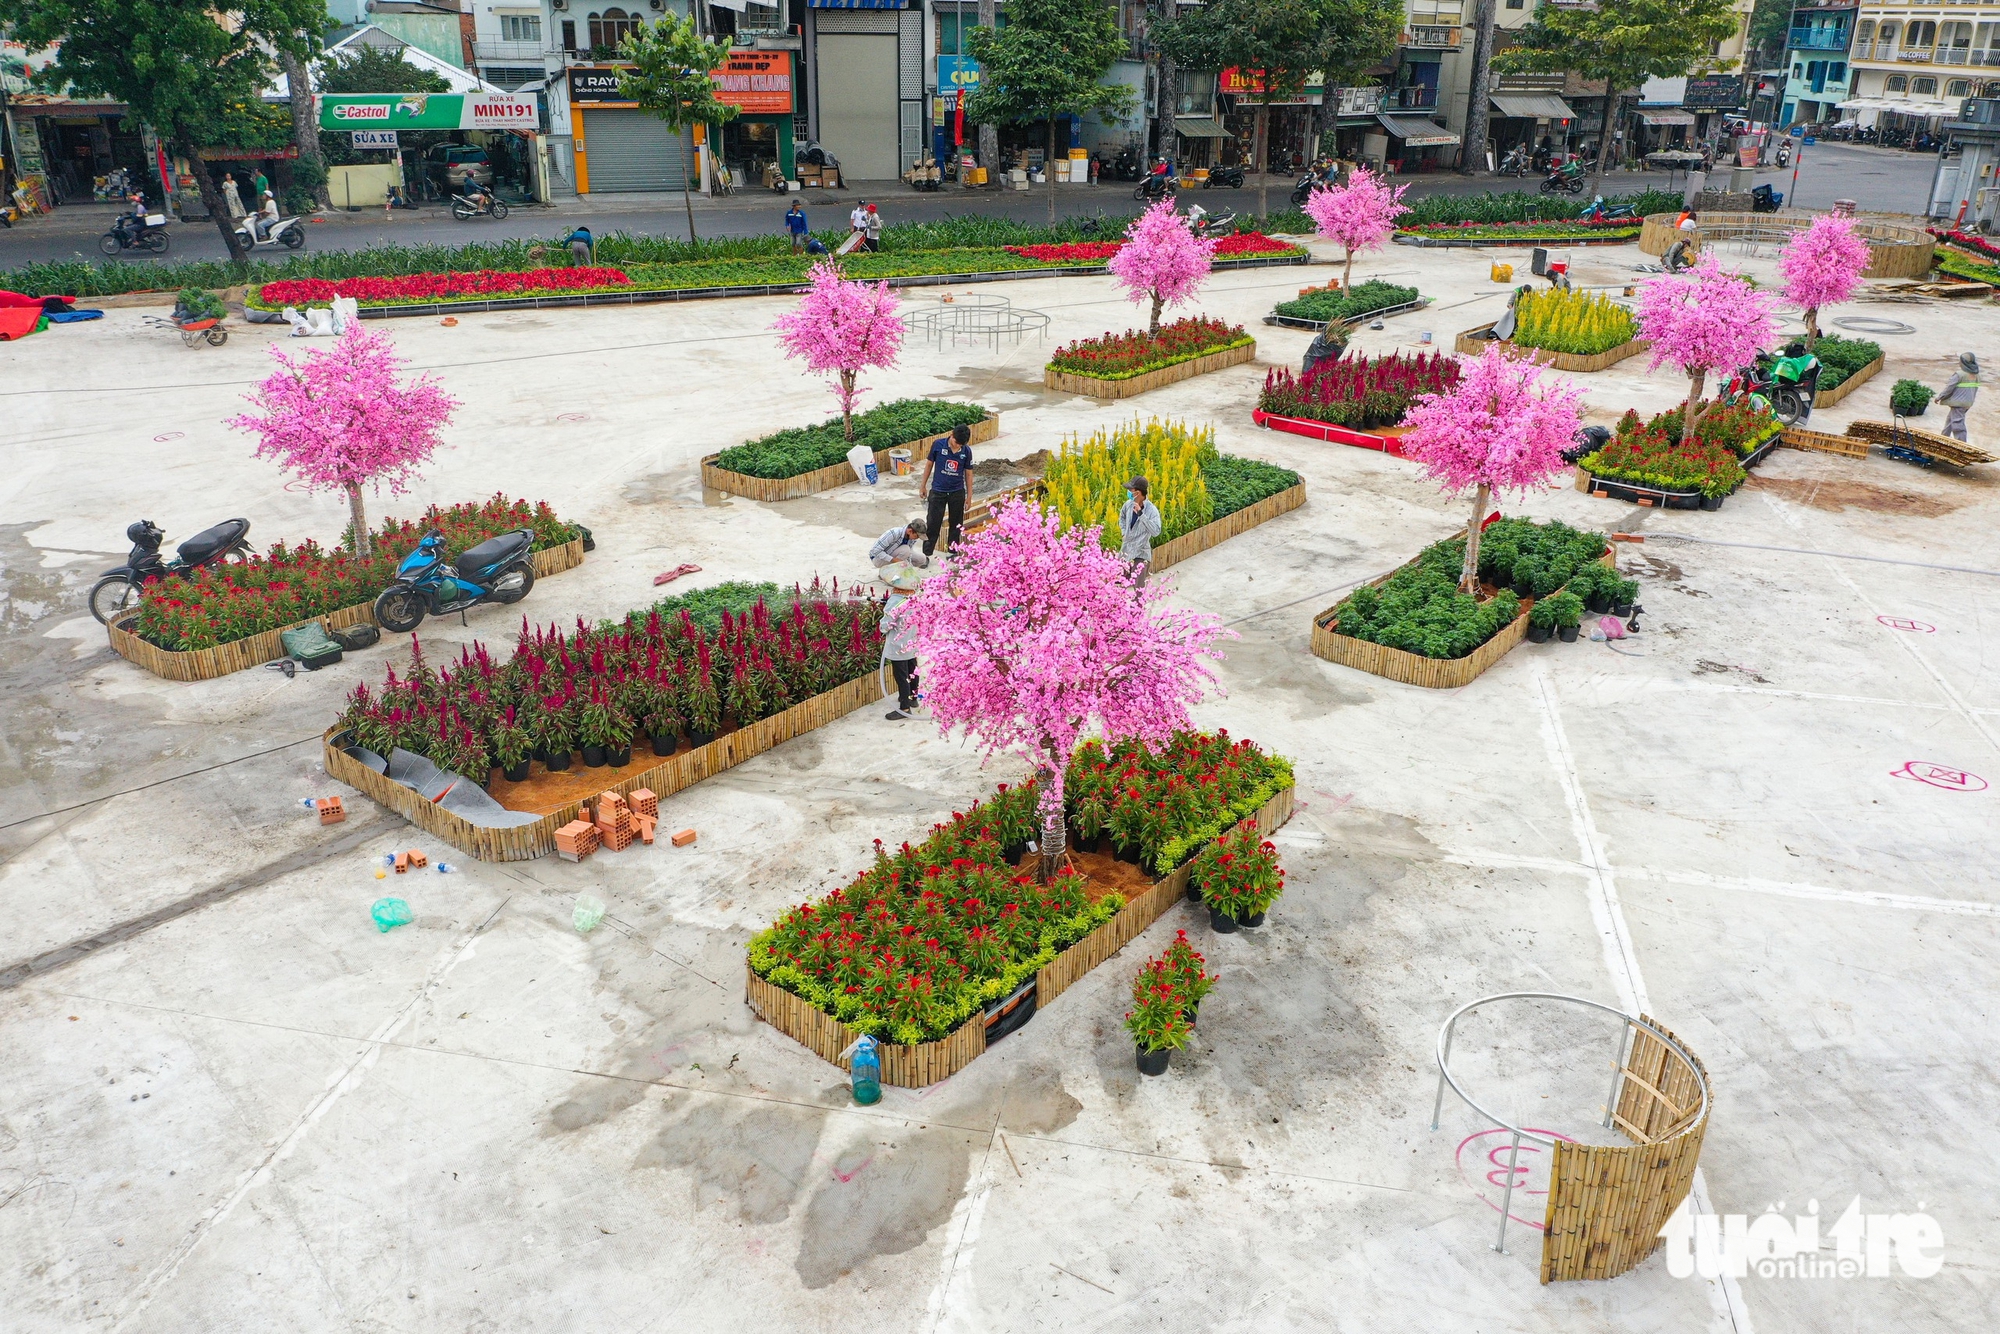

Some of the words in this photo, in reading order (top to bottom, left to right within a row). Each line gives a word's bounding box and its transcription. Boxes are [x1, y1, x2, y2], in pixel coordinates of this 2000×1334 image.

[1908, 51, 1930, 59] COFFEE
[588, 76, 620, 86] RAYN
[751, 74, 790, 91] KHANG
[348, 106, 387, 118] Castrol
[474, 104, 532, 117] MIN191
[354, 131, 377, 143] SỬA
[380, 134, 394, 143] XE
